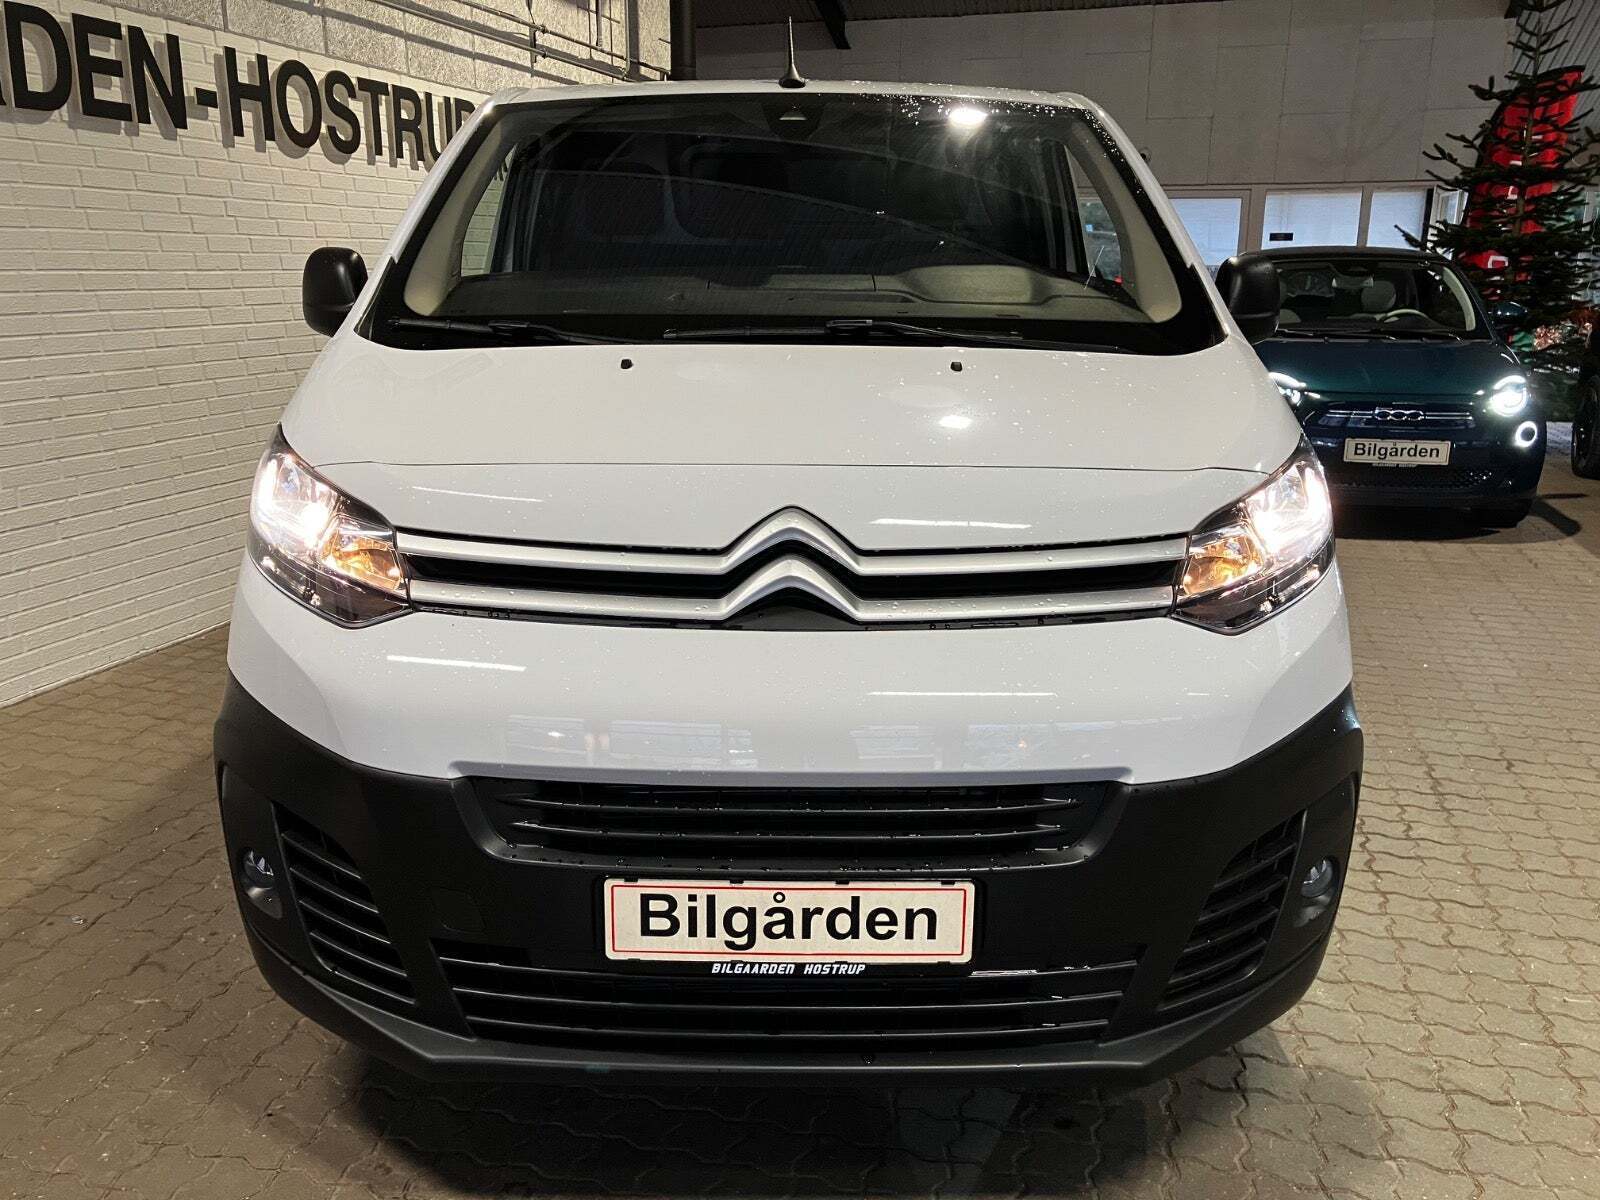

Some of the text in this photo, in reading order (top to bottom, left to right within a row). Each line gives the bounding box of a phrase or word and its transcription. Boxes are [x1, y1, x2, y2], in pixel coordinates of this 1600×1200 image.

[1353, 442, 1440, 460] Bilgården
[639, 891, 938, 951] Bilgården
[711, 962, 866, 976] BILGAARDEN HOSTRUP
